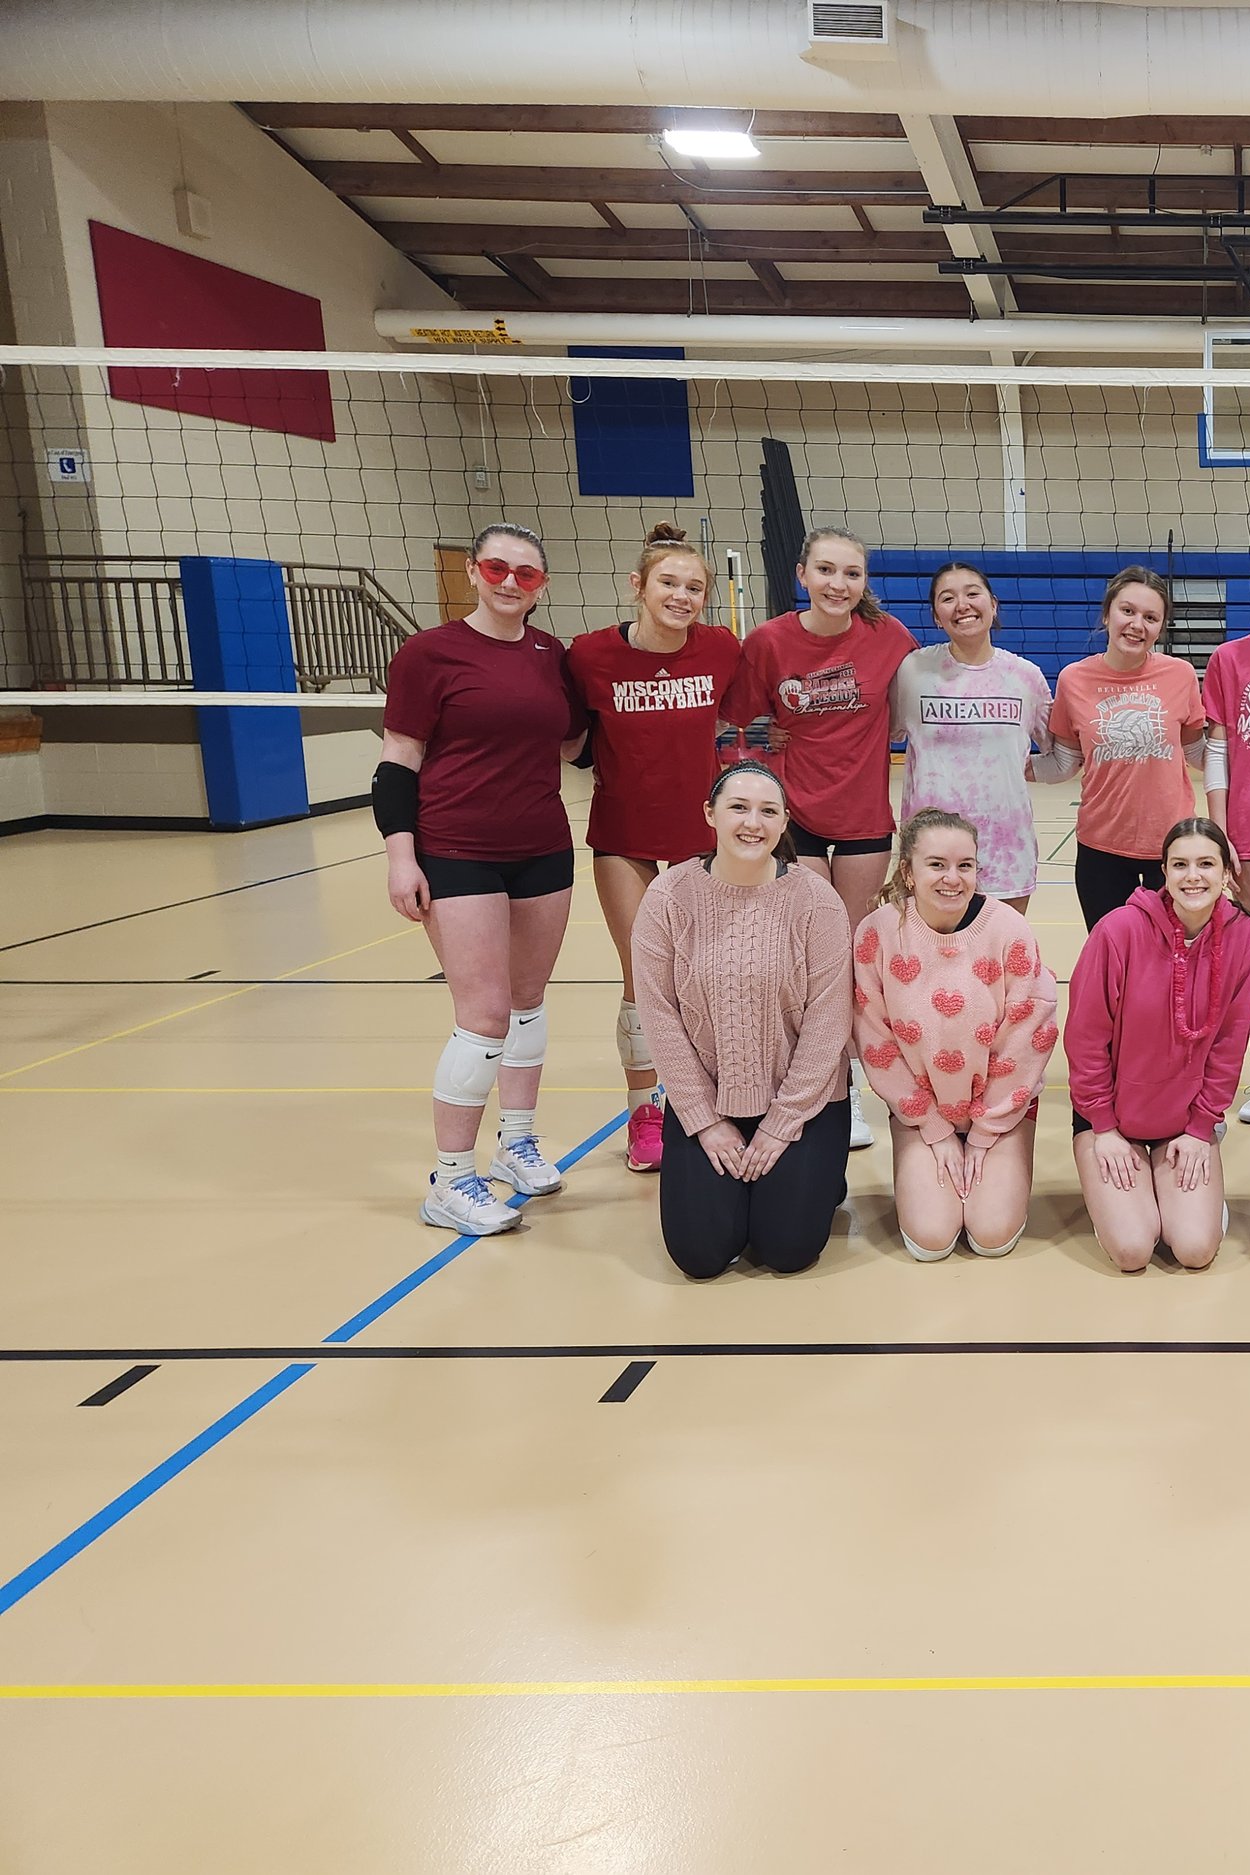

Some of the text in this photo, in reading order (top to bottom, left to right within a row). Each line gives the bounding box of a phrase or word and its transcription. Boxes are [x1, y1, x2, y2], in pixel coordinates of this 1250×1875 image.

[454, 330, 471, 338] WATER
[612, 675, 714, 697] WISCONSIN
[801, 677, 856, 694] BADGER
[1097, 683, 1158, 693] BELLEVILLE
[613, 690, 715, 713] VOLLEYBALL
[809, 688, 860, 706] REGION
[1096, 692, 1161, 713] WILDCATS
[793, 697, 869, 716] Championships
[925, 702, 1019, 719] AREARED
[1093, 742, 1174, 768] Volleyball
